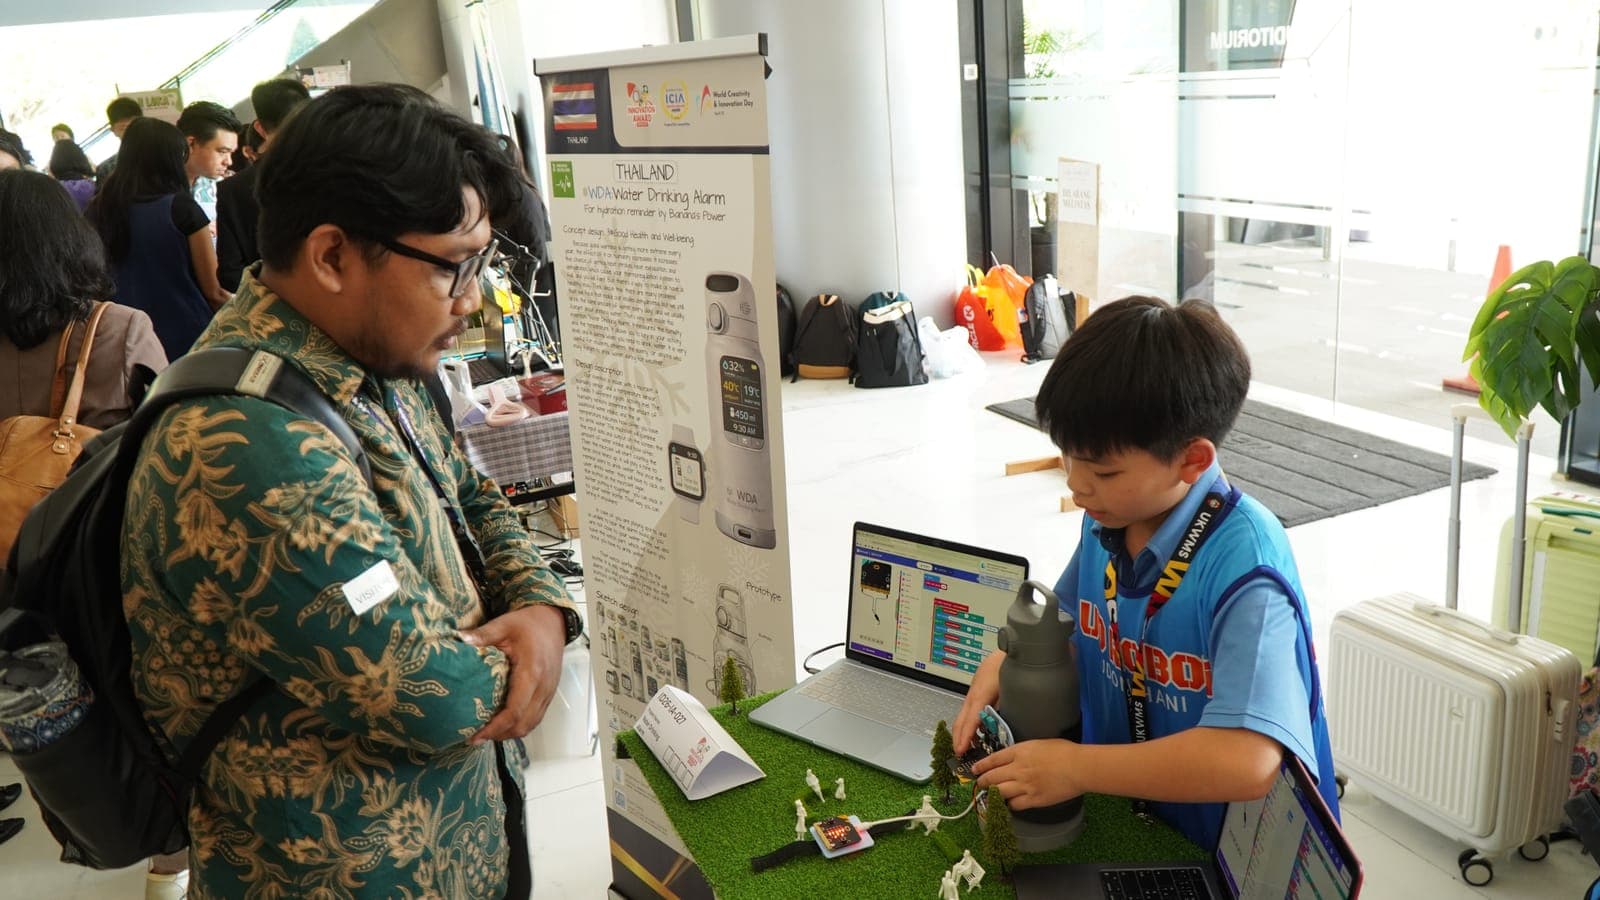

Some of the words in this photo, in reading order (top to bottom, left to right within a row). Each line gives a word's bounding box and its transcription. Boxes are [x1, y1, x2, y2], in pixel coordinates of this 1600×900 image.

[665, 92, 686, 104] ICIA
[728, 90, 750, 98] Creativity
[718, 100, 743, 108] Innovation
[744, 99, 754, 108] Day
[566, 136, 589, 144] THAILAND
[615, 163, 675, 181] THAILAND
[647, 188, 689, 210] Drinking
[694, 190, 726, 205] Alarm
[584, 204, 595, 213] For
[597, 204, 625, 218] hydration
[627, 208, 656, 216] reminder
[658, 209, 667, 221] by
[702, 211, 726, 221] Power
[562, 225, 586, 236] Concept
[651, 232, 661, 240] and
[662, 233, 695, 247] Well-being
[735, 410, 749, 420] 450
[736, 490, 758, 505] WDA
[1178, 511, 1212, 559] UKWMS
[745, 581, 782, 602] Prototype
[595, 590, 617, 608] Sketch
[619, 602, 640, 619] design
[1134, 700, 1146, 742] UKWMS
